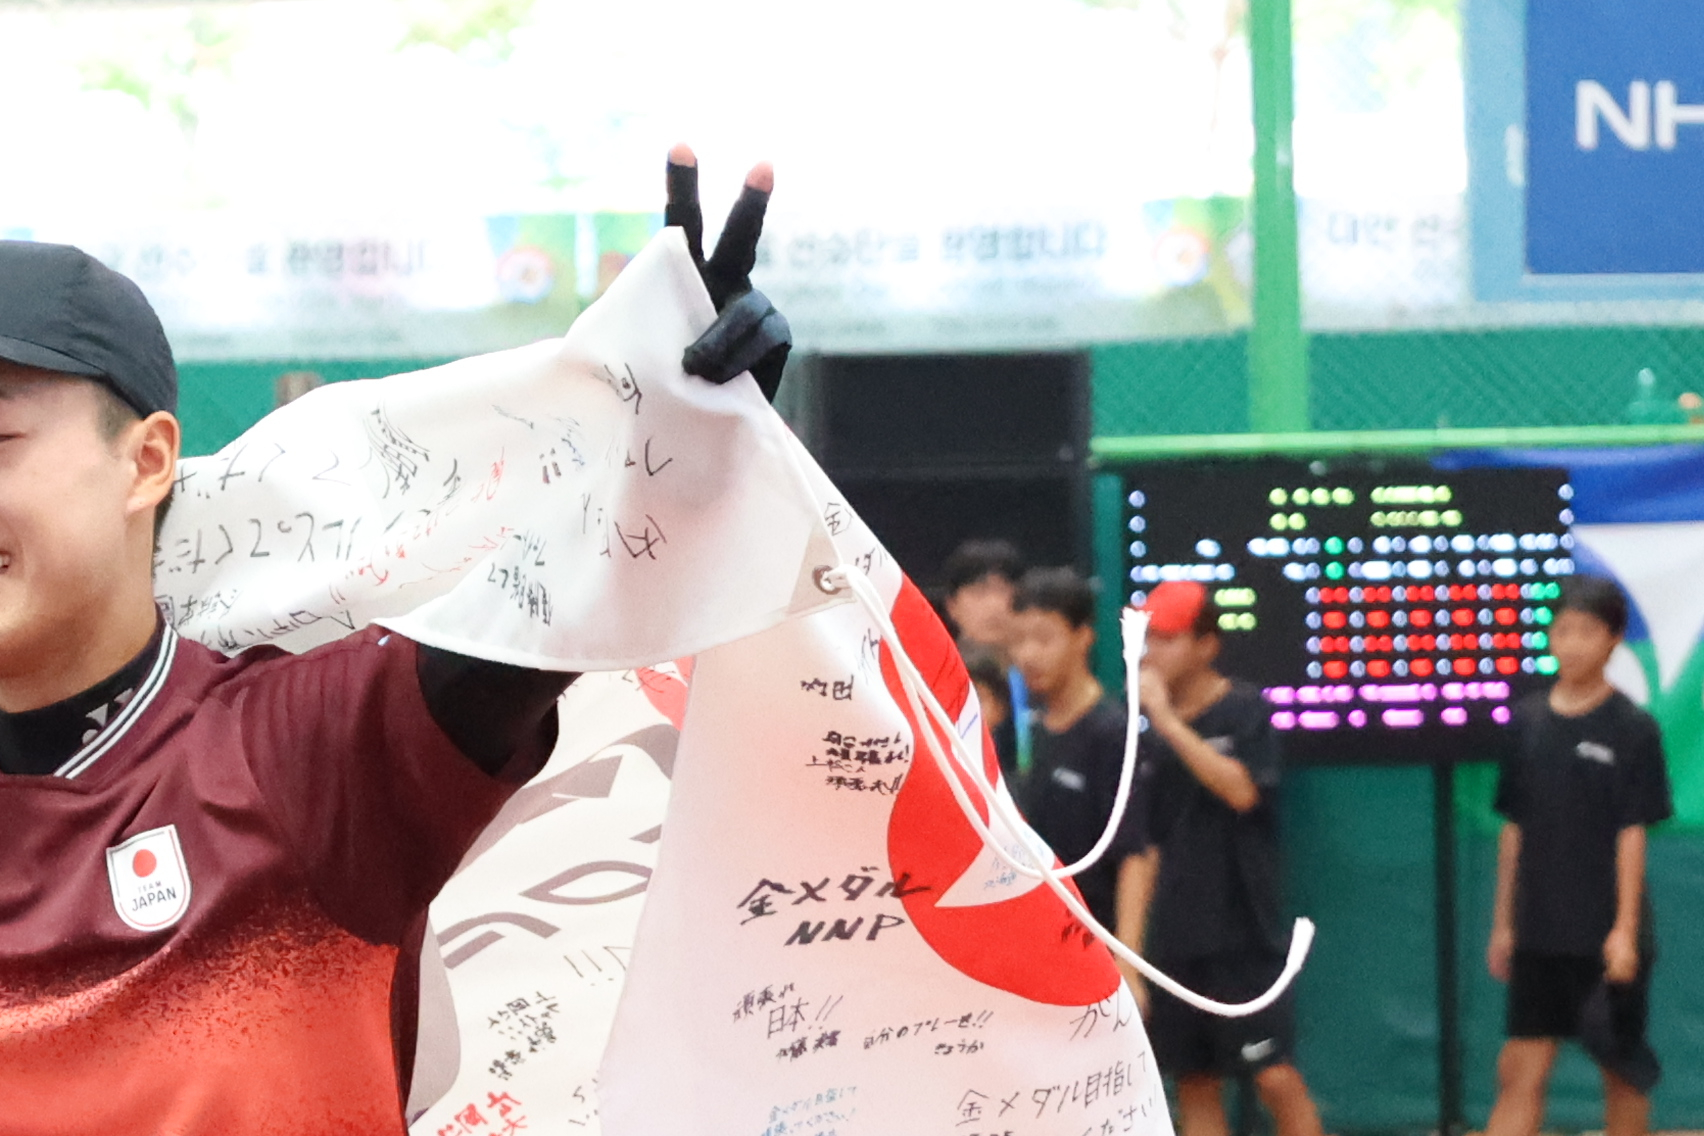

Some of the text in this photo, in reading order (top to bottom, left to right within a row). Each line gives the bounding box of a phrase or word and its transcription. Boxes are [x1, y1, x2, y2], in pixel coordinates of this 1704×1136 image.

[130, 886, 178, 913] JAPAN
[137, 879, 164, 893] TEAM
[737, 867, 933, 926] 金メダル
[954, 1052, 1150, 1130] 金メダル目指して
